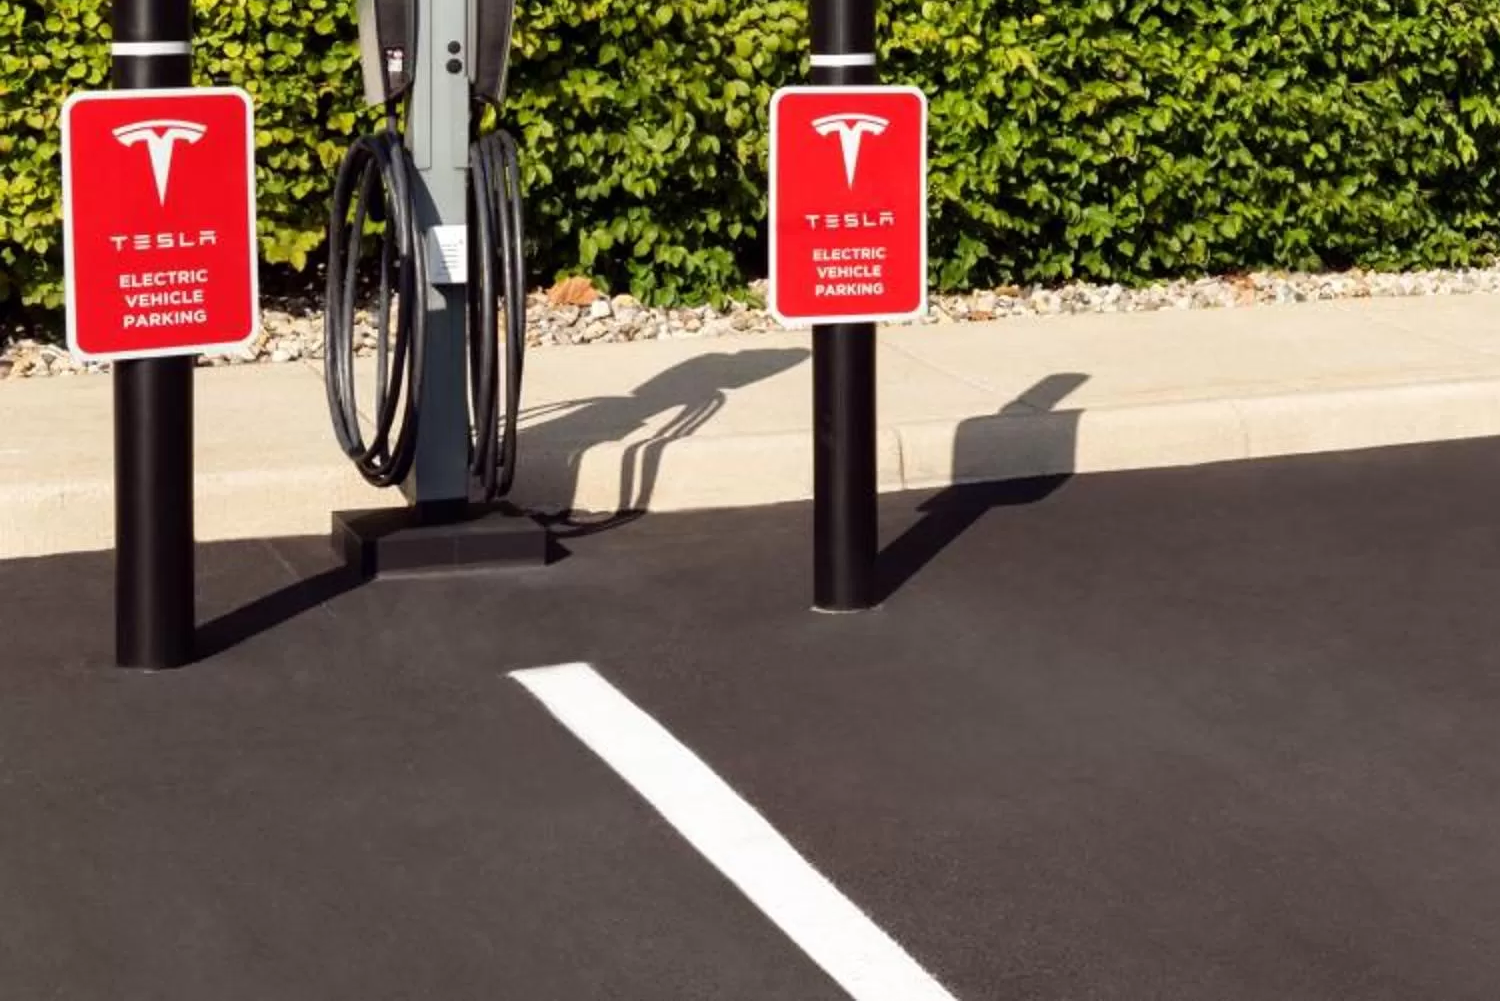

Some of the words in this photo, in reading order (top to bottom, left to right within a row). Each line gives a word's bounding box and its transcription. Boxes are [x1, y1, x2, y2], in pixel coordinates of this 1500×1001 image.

[805, 212, 895, 229] TESLA
[109, 230, 217, 251] TESLA
[812, 247, 886, 262] ELECTRIC
[119, 269, 208, 288] ELECTRIC
[817, 264, 882, 279] VEHICLE
[125, 289, 204, 308] VEHICLE
[815, 282, 884, 297] PARKING
[122, 309, 208, 328] PARKING
